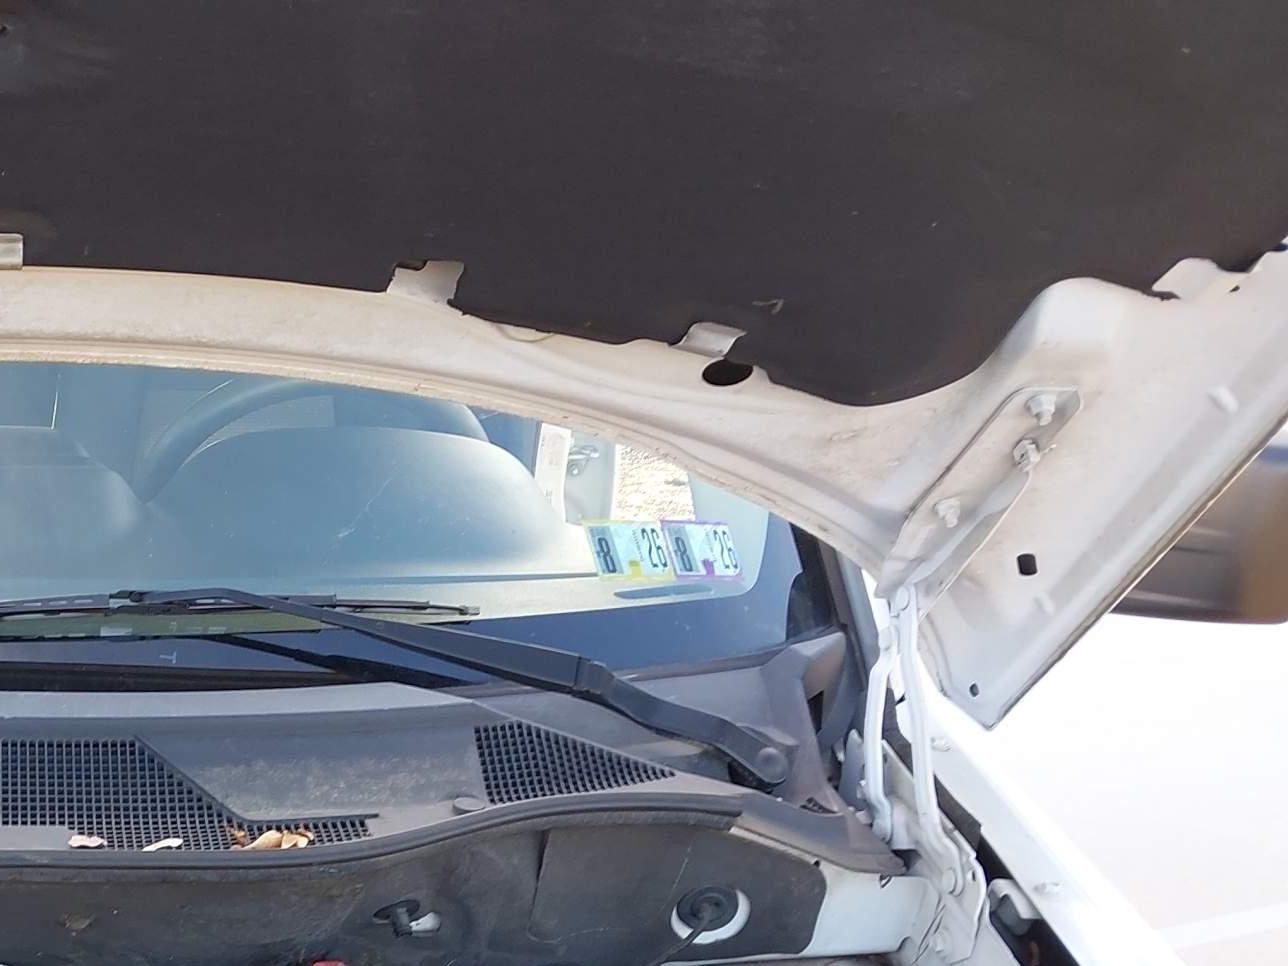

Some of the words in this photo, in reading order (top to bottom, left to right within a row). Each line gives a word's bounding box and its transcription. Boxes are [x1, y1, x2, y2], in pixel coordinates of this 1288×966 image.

[597, 537, 617, 573] 8
[641, 527, 669, 569] 26
[675, 536, 693, 573] 8
[713, 529, 738, 569] 26
